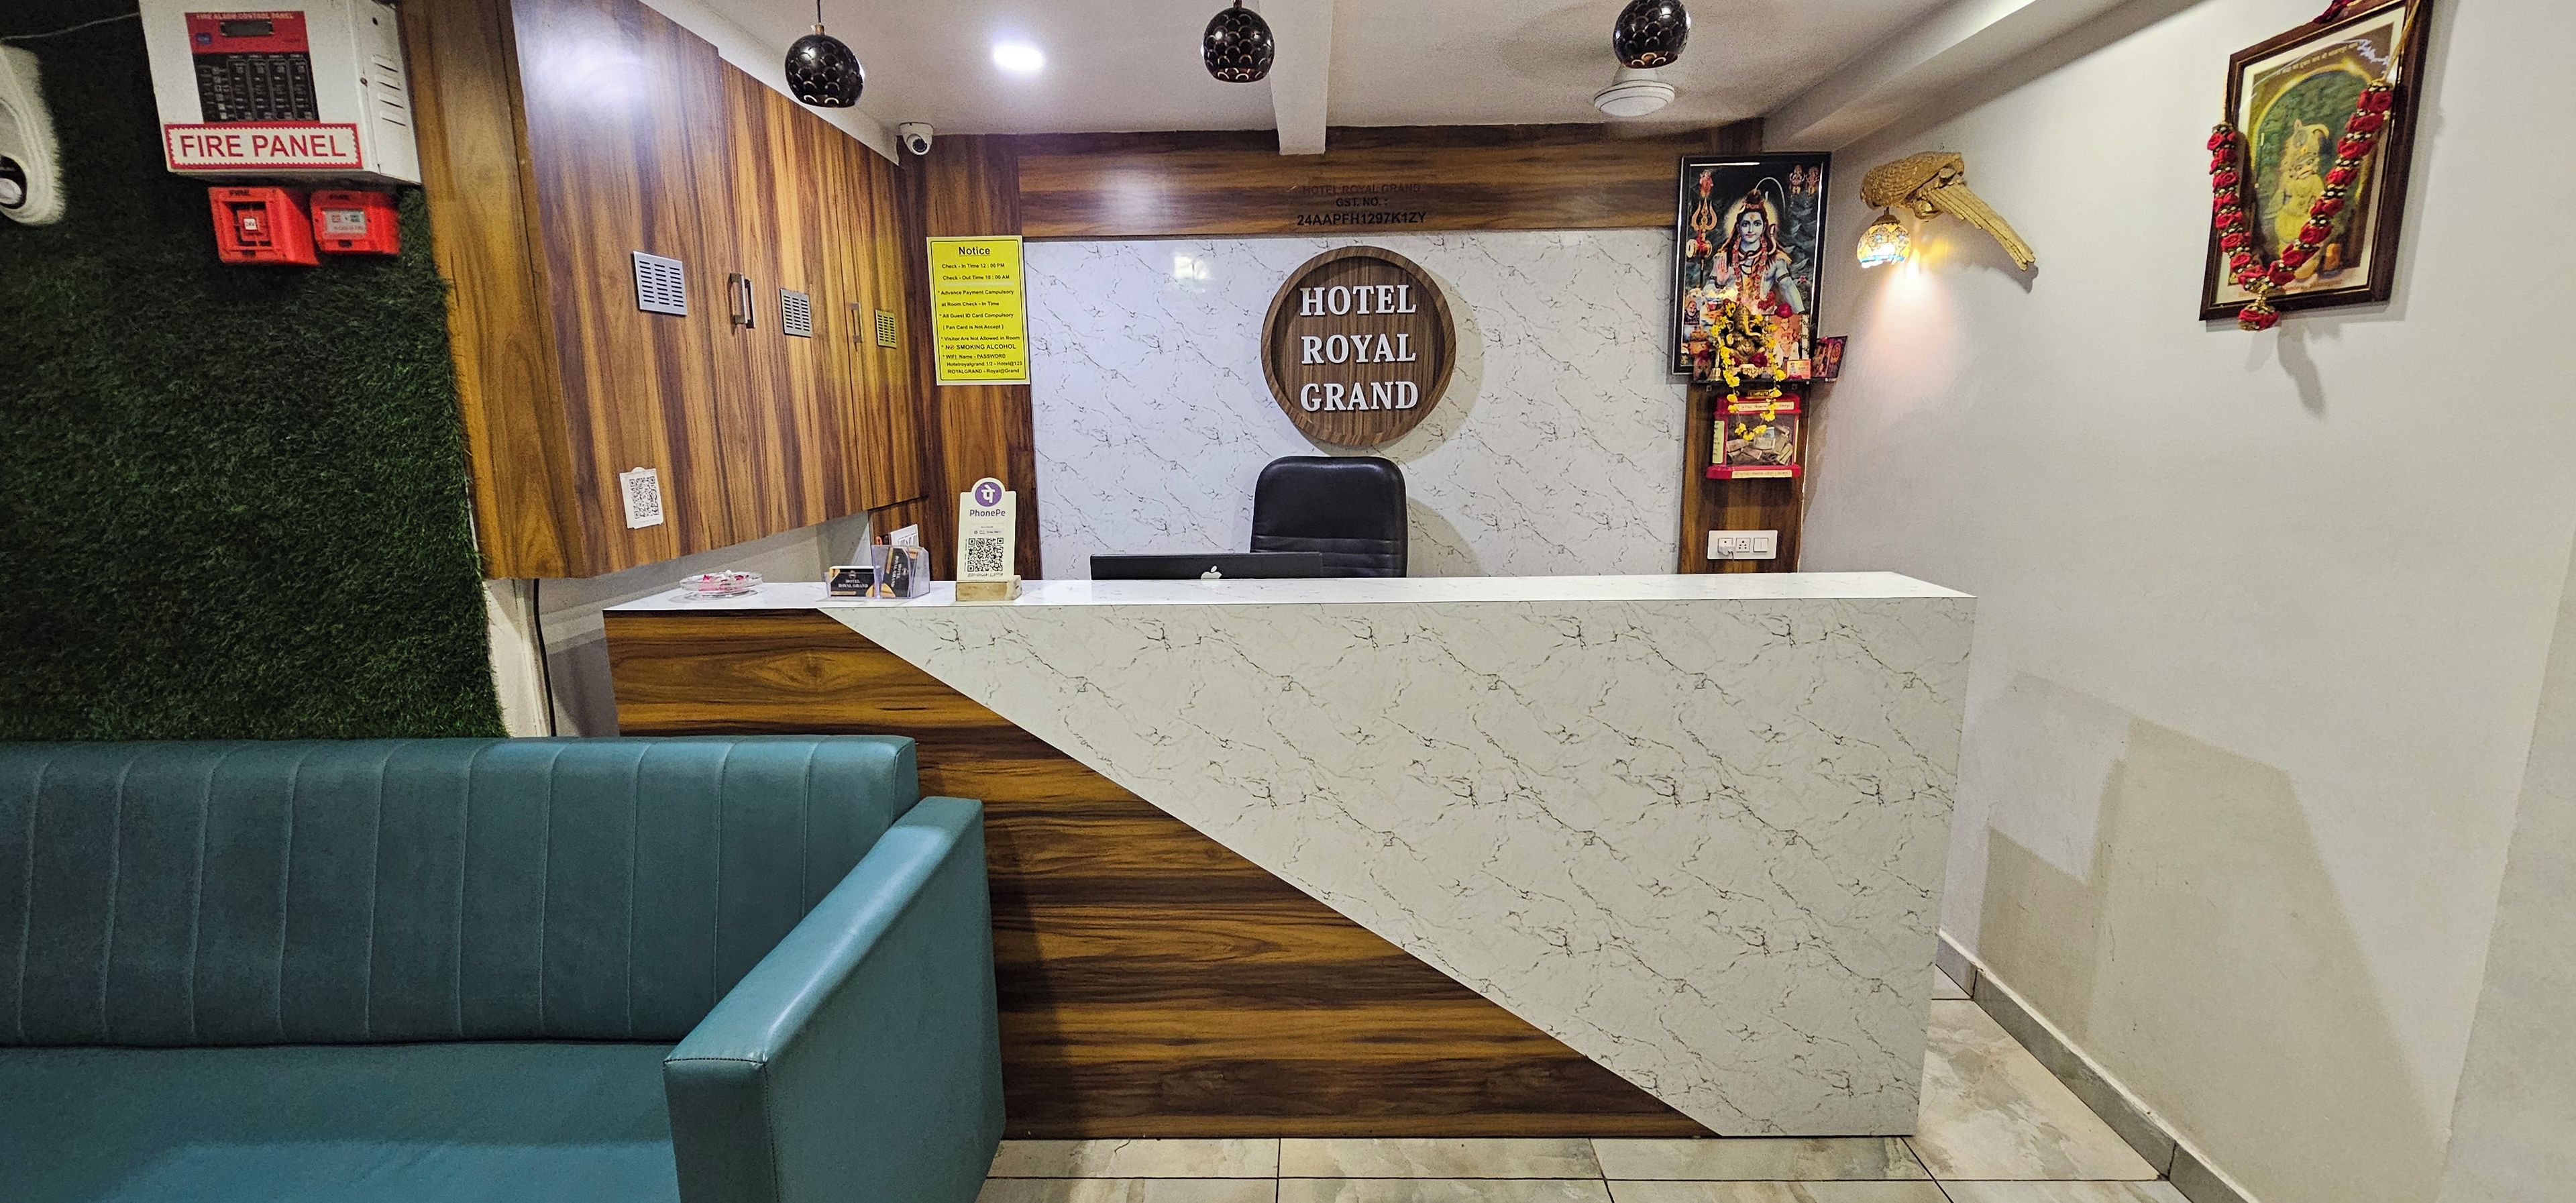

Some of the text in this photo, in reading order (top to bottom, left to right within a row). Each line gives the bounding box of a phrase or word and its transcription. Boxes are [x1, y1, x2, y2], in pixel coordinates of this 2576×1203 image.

[179, 135, 346, 158] FIRE PANEL
[1303, 184, 1421, 195] HOTEL ROYAL GRAND
[1336, 198, 1360, 207] GST.
[1363, 197, 1381, 206] NO.
[1297, 212, 1426, 225] 24AAPFH1297K1ZY
[959, 246, 990, 255] Notice
[1300, 284, 1417, 316] HOTEL
[1301, 333, 1416, 364] ROYAL
[1300, 381, 1419, 411] GRAND
